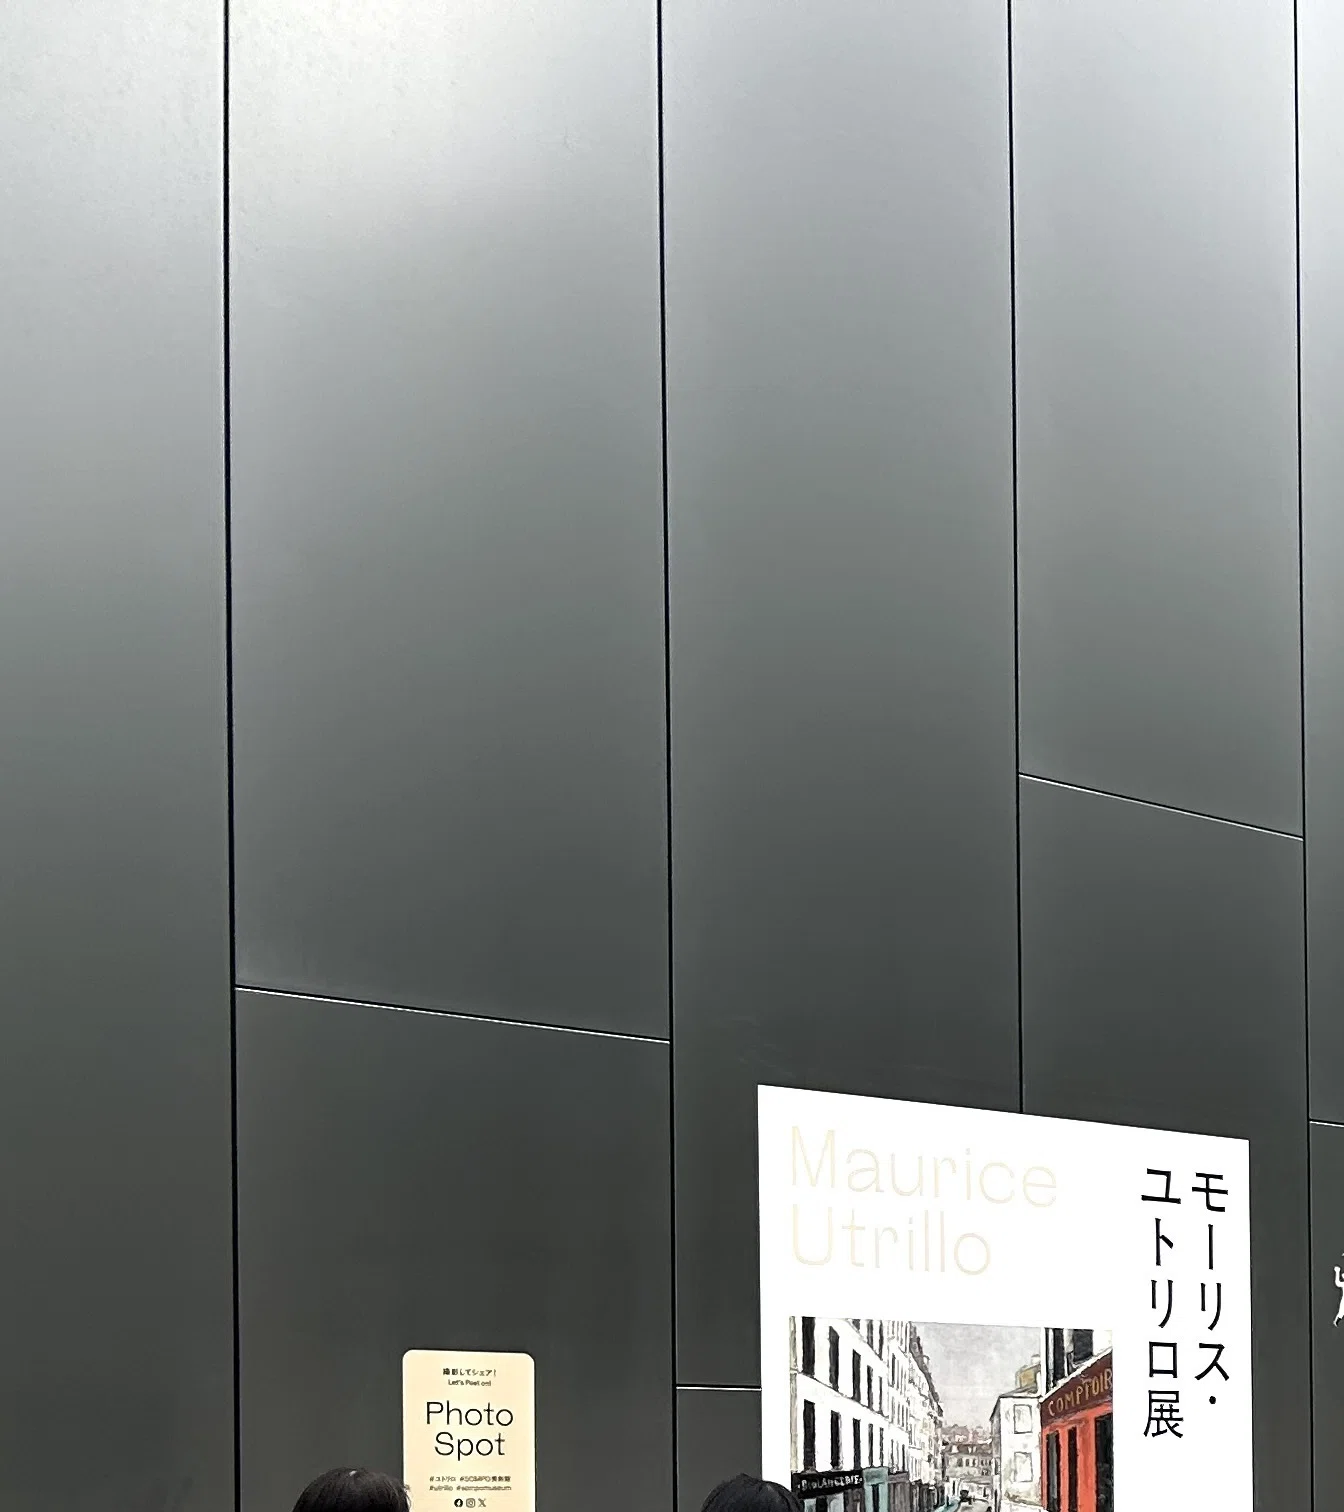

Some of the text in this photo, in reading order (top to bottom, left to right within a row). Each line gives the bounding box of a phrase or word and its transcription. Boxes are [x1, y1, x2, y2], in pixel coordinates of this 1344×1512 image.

[792, 1125, 1057, 1208] Maurice
[792, 1203, 991, 1276] Utrillo
[1141, 1168, 1184, 1439] ユトリロ展
[1192, 1172, 1230, 1405] モーリス・
[426, 1400, 514, 1427] Photo
[434, 1431, 505, 1462] Spot
